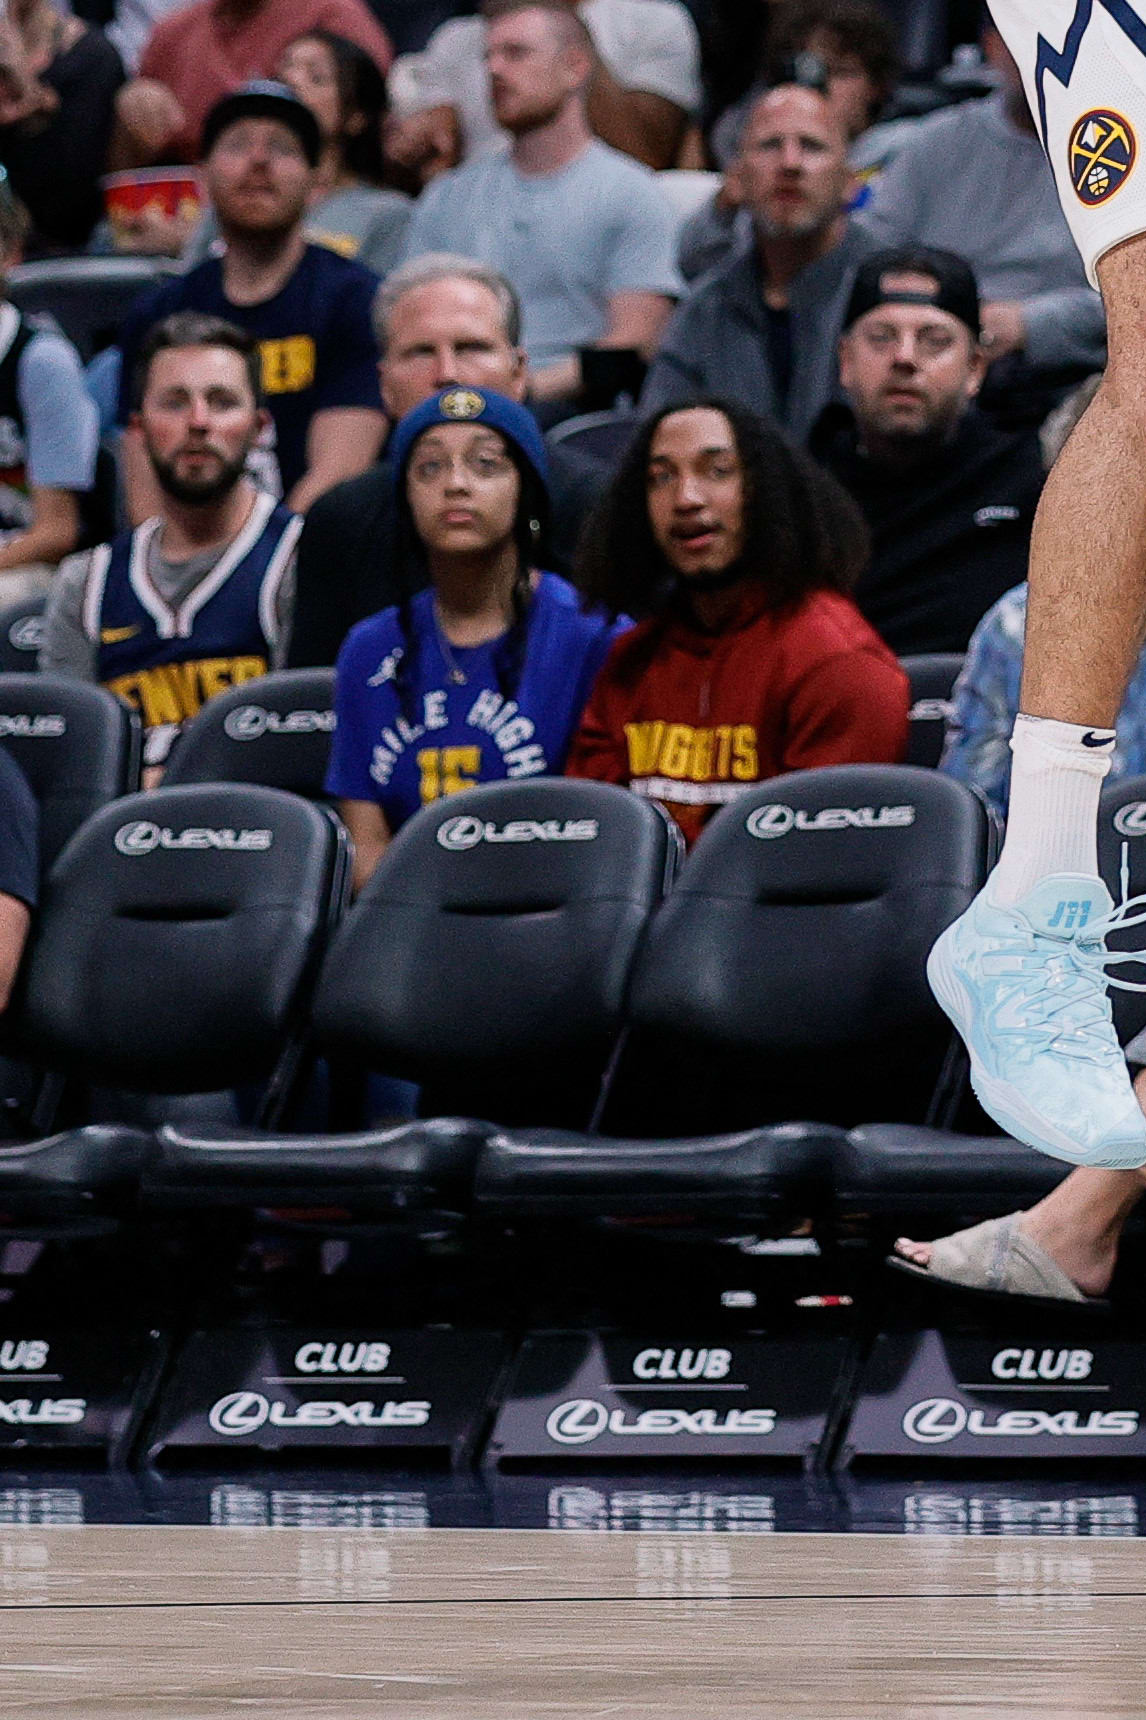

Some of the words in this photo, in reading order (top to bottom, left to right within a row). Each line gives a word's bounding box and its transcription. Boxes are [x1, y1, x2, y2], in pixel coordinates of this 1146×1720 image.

[370, 690, 448, 786] MILE
[466, 688, 548, 777] HIGH
[484, 819, 600, 842] LEXUS
[794, 805, 917, 831] LEXUS
[160, 828, 274, 850] LEXUS
[294, 1342, 392, 1373] CLUB
[632, 1348, 733, 1380] CLUB
[991, 1348, 1094, 1380] CLUB
[268, 1400, 432, 1427] LEXUS
[608, 1408, 777, 1435] LEXUS
[966, 1409, 1140, 1436] LEXUS
